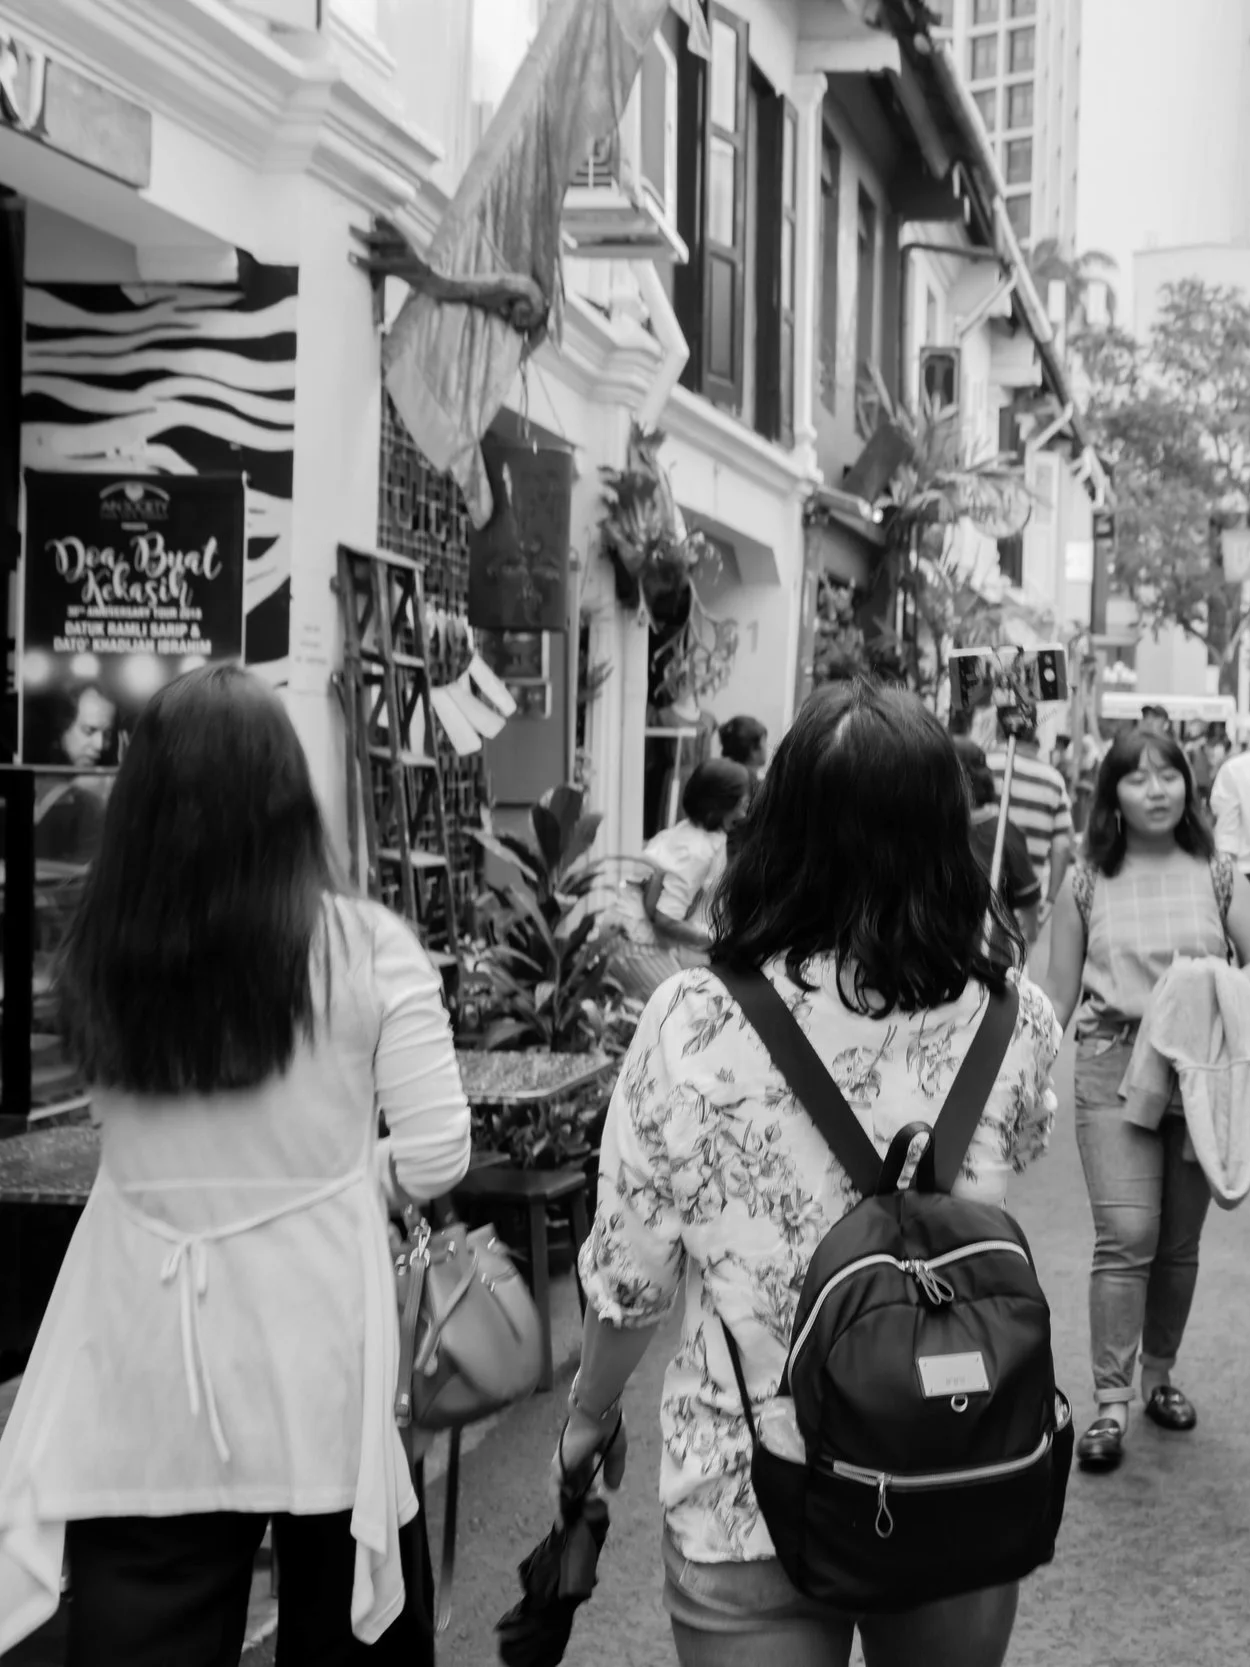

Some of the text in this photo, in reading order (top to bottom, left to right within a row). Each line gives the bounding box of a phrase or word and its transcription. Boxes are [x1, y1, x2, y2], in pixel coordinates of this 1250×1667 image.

[45, 531, 222, 584] Doa Buat
[82, 561, 193, 610] Kekasih
[65, 621, 104, 637] DATUK
[107, 621, 147, 637] RAMLI
